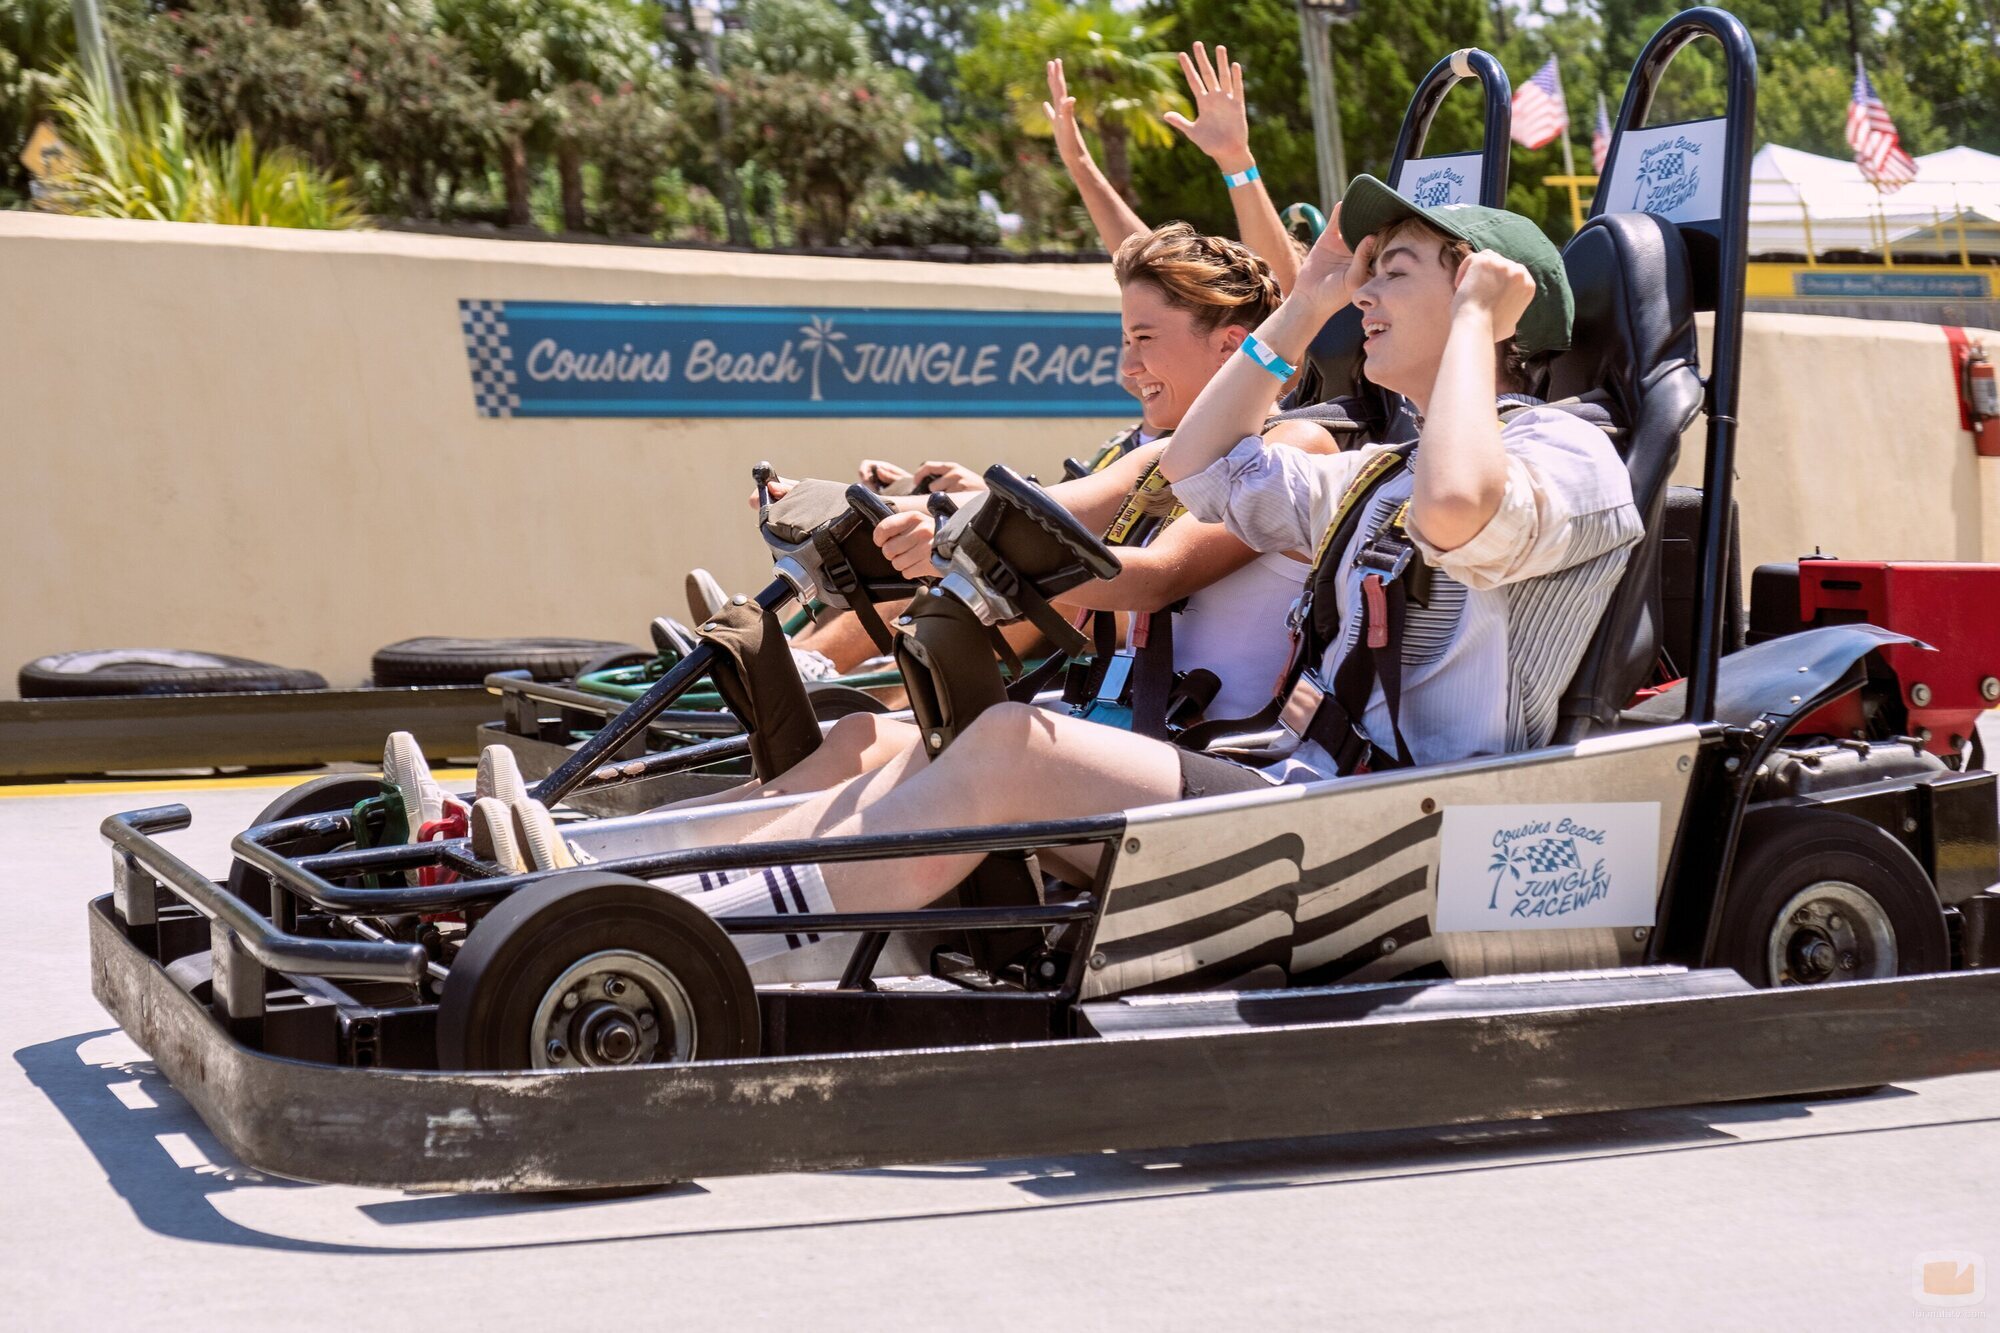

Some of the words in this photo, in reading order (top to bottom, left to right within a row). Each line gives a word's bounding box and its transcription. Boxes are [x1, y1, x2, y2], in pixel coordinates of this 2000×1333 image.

[1641, 139, 1673, 163] Cousins
[1674, 136, 1702, 156] Beach
[1443, 167, 1464, 187] Beach
[1643, 176, 1700, 214] RACEWAY
[1647, 165, 1699, 200] JUNGLE
[525, 339, 671, 384] Cousins
[684, 339, 803, 384] Beach
[845, 343, 1000, 387] JUNGLE
[1009, 343, 1123, 387] RACE
[1492, 820, 1551, 848] Cousins
[1556, 817, 1606, 845] Beach
[1515, 858, 1606, 898] JUNGLE
[1510, 874, 1612, 919] RACEWAY
